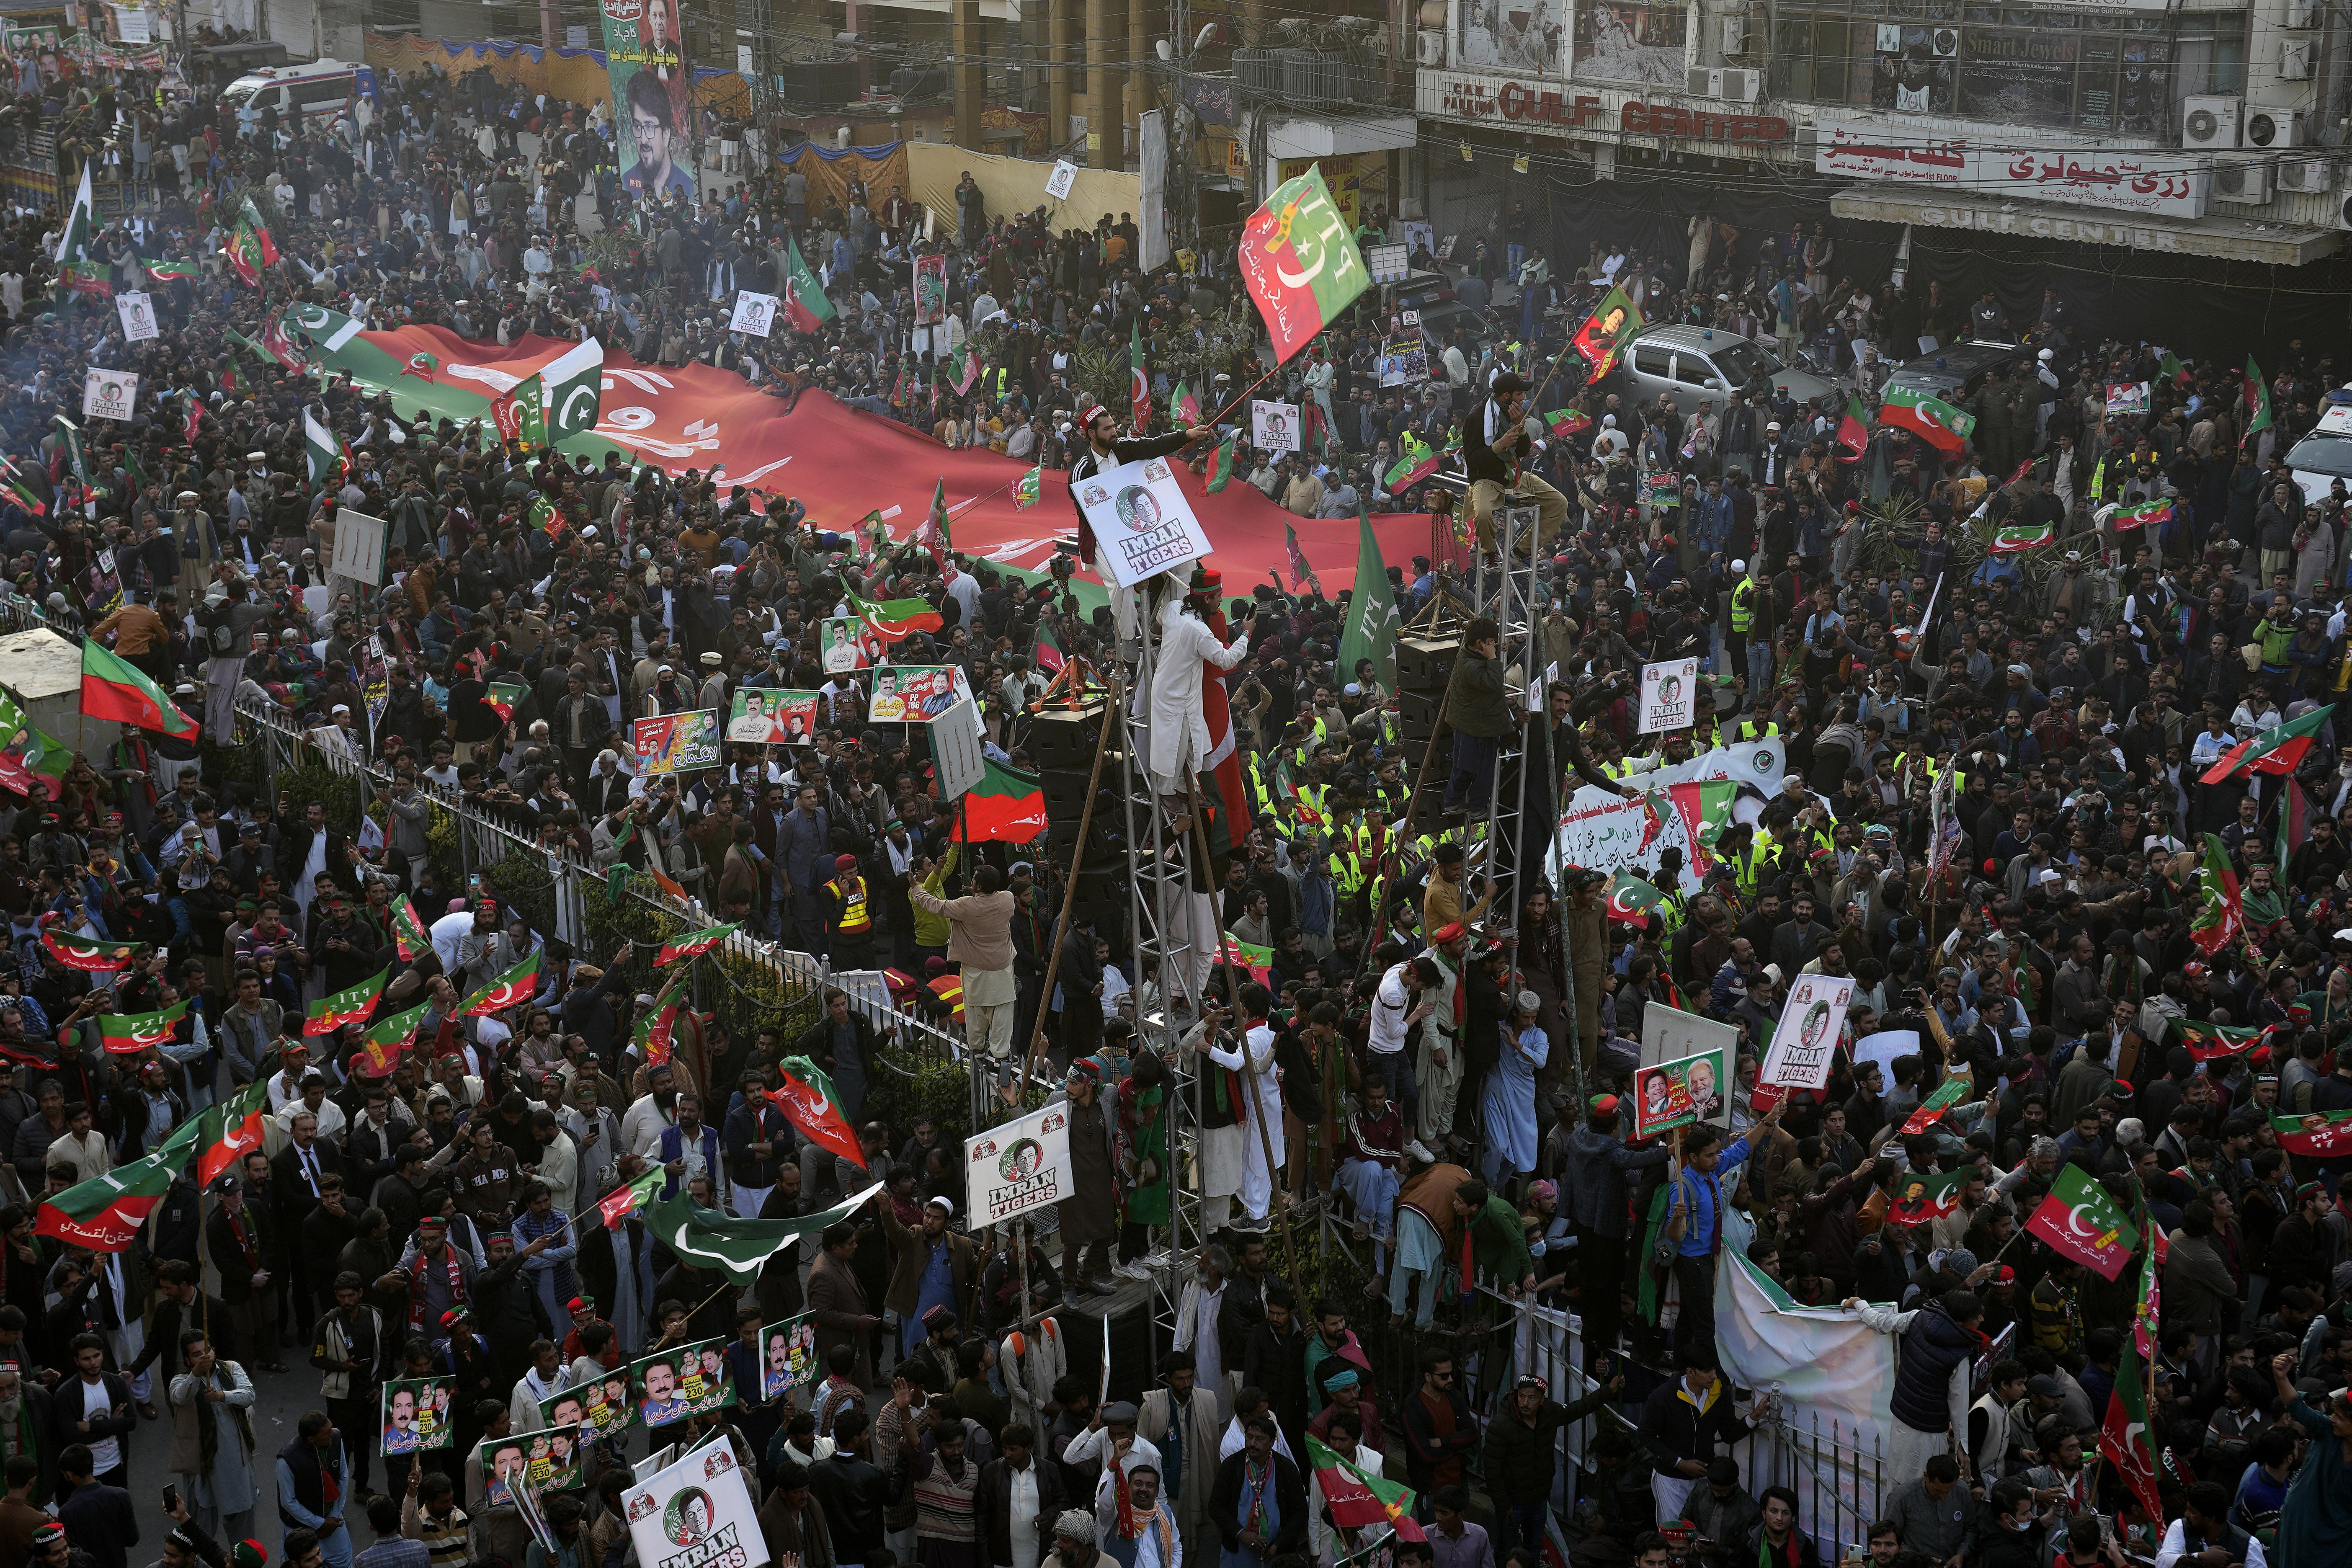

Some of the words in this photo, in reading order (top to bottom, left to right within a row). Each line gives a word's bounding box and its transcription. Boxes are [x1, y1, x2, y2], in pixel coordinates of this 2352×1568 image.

[1967, 32, 2017, 56] Smart
[2021, 37, 2074, 62] Jewels
[609, 47, 621, 64] چلو
[622, 45, 652, 66] راولپنڈی
[652, 49, 665, 68] چلو
[665, 50, 678, 68] چلو
[1454, 83, 1483, 96] CAR
[1499, 82, 1599, 126] GULF
[1622, 101, 1789, 147] CENTER
[2009, 154, 2123, 191] جیولری
[1049, 185, 1065, 195] TIGERS
[1052, 179, 1068, 189] IMRAN
[2132, 170, 2190, 199] زری
[1924, 208, 2016, 230] GULF
[2030, 218, 2177, 247] CENTER
[797, 268, 811, 288] PTI
[129, 320, 151, 331] IMRAN
[738, 316, 766, 327] IMRAN
[131, 328, 153, 338] TIGERS
[737, 323, 765, 335] TIGERS
[1893, 385, 1921, 398] PTI
[91, 397, 126, 411] IMRAN
[527, 389, 539, 427] PTI
[91, 406, 126, 418] TIGERS
[1261, 430, 1292, 441] IMRAN
[1261, 438, 1292, 449] TIGERS
[1032, 464, 1041, 493] PTI
[1157, 472, 1172, 481] حقیقی
[1097, 495, 1112, 504] حقیقی
[1118, 518, 1186, 557] IMRAN
[1127, 536, 1194, 575] TIGERS
[858, 599, 887, 614] PTI
[908, 701, 920, 709] 186
[1651, 701, 1687, 716] IMRAN
[1651, 713, 1685, 729] TIGERS
[672, 750, 695, 768] مارچ
[694, 745, 718, 764] لانگ
[847, 892, 864, 904] ESCUE
[132, 1014, 165, 1030] PTI
[1782, 1044, 1827, 1065] IMRAN
[1777, 1063, 1823, 1084] TIGERS
[1643, 1113, 1667, 1124] NA-139
[1054, 1122, 1069, 1131] حقیقی
[2311, 1131, 2335, 1142] PP
[985, 1150, 1002, 1158] حقیقی
[988, 1167, 1057, 1206] IMRAN
[989, 1184, 1058, 1219] TIGERS
[2080, 1183, 2116, 1214] PTI
[791, 1359, 802, 1370] 230
[686, 1386, 704, 1398] 230
[705, 1385, 733, 1407] عمران
[593, 1413, 609, 1426] 230
[418, 1422, 432, 1432] 230
[532, 1468, 550, 1479] 230
[719, 1462, 738, 1475] حقیقی
[705, 1470, 720, 1483] آزادی
[1329, 1493, 1350, 1502] انصاف
[643, 1505, 662, 1519] حقیقی
[628, 1513, 643, 1526] آزادی
[658, 1521, 741, 1568] IMRAN
